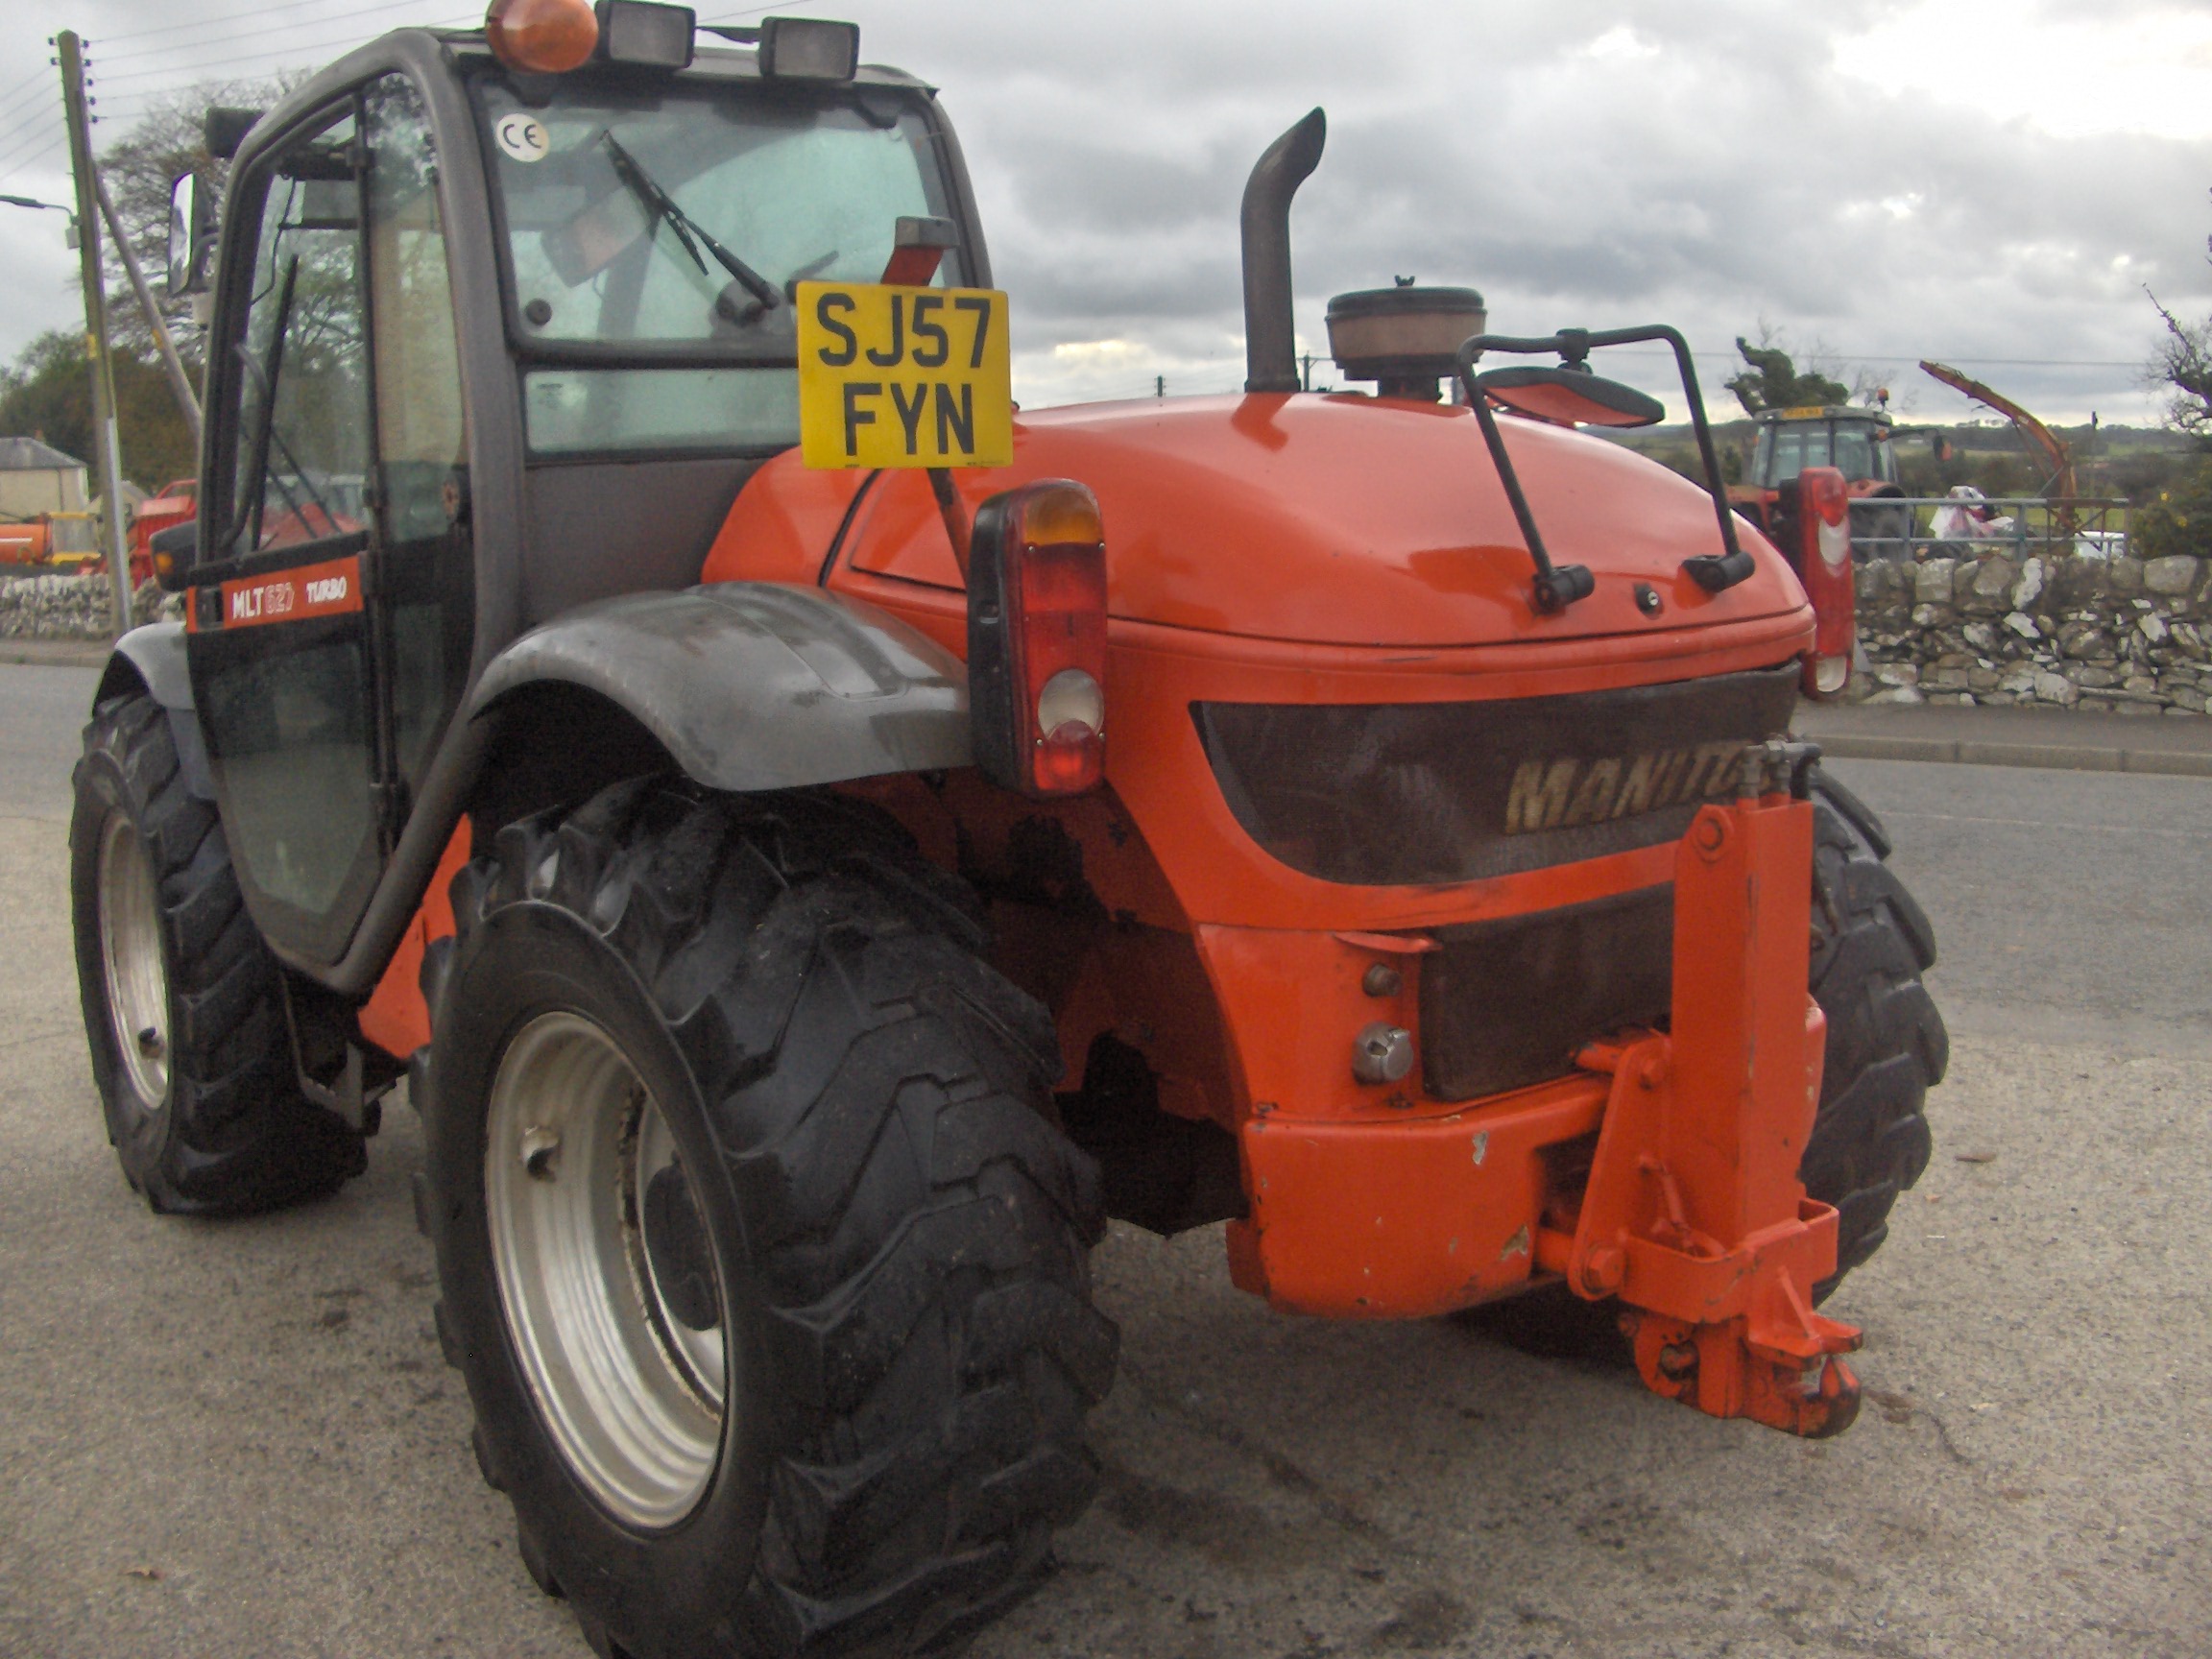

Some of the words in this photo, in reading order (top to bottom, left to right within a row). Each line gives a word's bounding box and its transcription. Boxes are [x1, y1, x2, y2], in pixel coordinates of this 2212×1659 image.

[502, 123, 541, 149] CE
[817, 292, 991, 368] SJ57
[843, 382, 975, 457] FYN
[306, 576, 348, 604] TURBO
